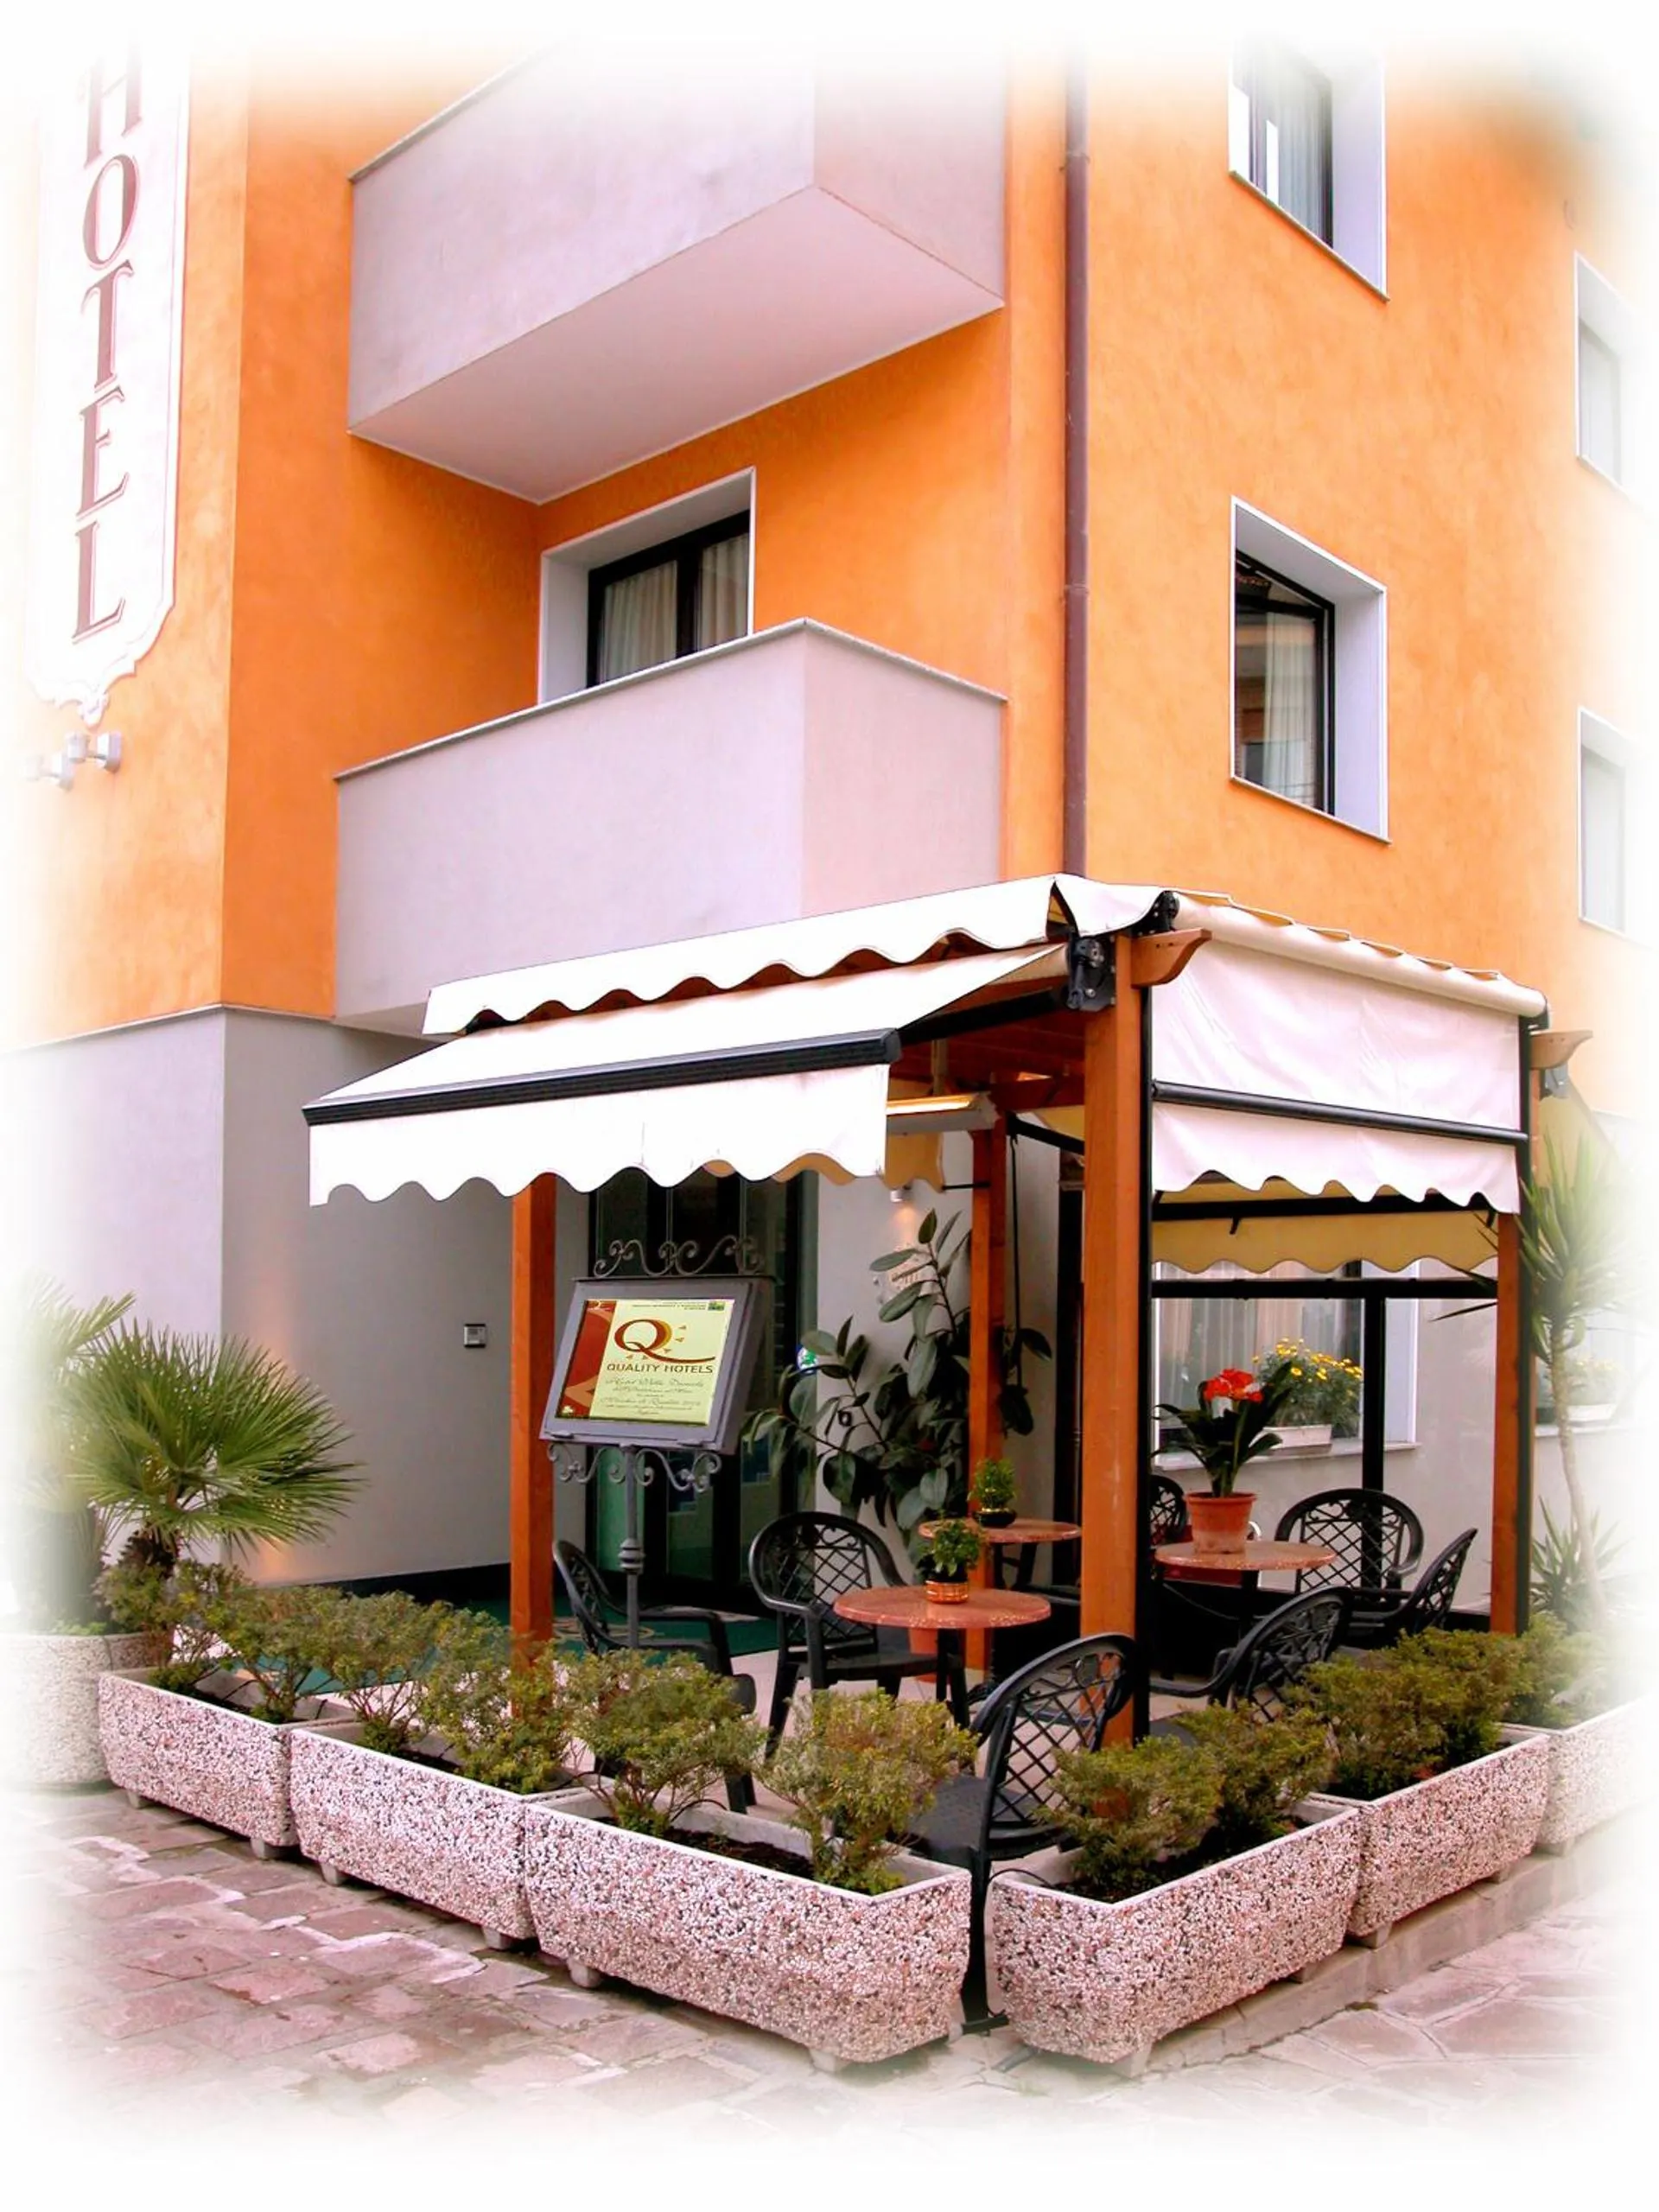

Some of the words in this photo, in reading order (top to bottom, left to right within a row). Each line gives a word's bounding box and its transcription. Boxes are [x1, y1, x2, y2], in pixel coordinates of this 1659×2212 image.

[73, 40, 143, 645] HOTEL
[614, 1319, 715, 1363] Q
[607, 1363, 660, 1373] QUALITY
[664, 1364, 714, 1374] HOTELS
